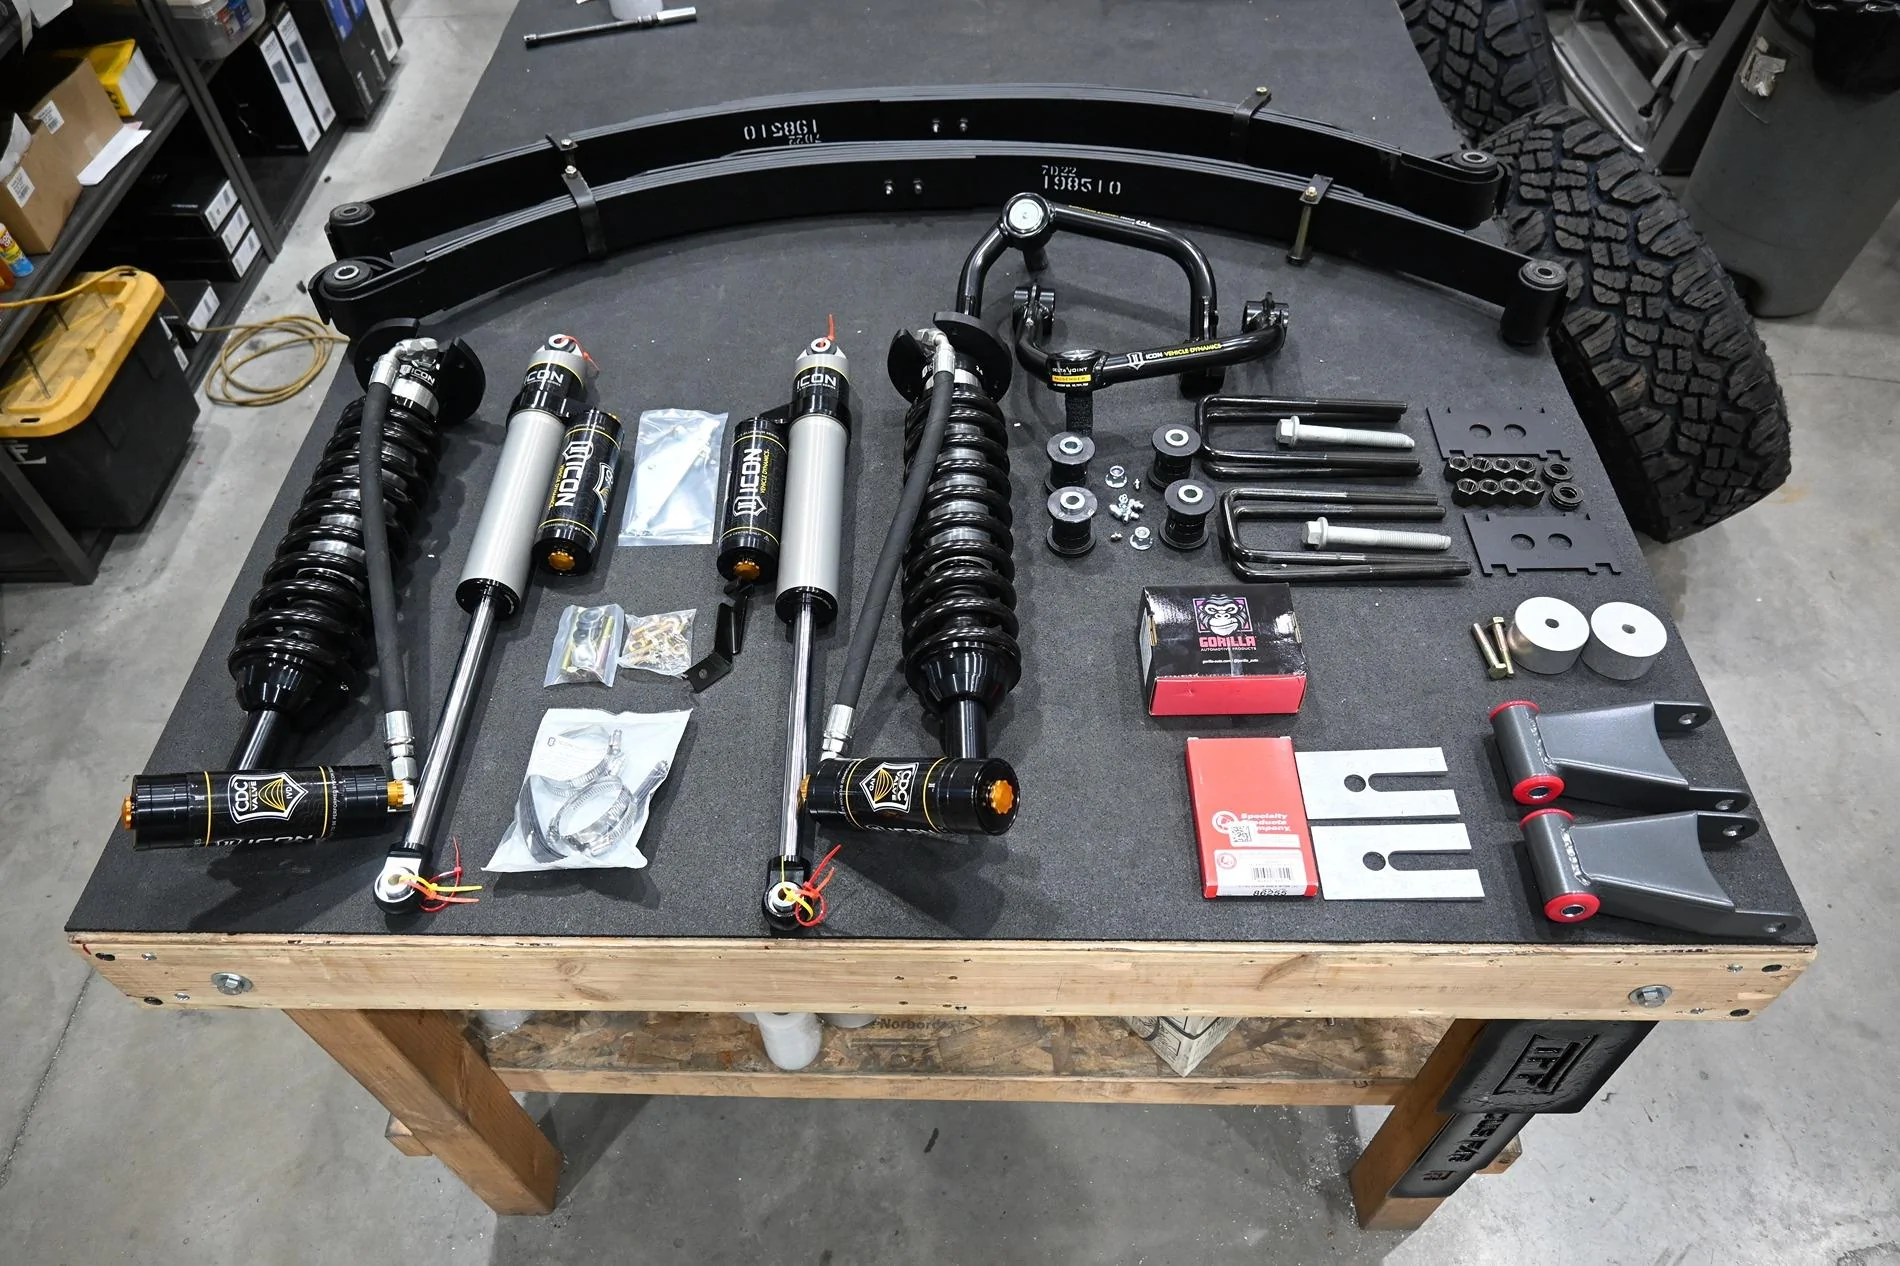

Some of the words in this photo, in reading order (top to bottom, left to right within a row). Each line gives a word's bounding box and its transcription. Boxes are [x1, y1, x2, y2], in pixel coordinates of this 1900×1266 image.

[743, 119, 817, 140] 198510
[1044, 175, 1121, 195] 198510
[1145, 351, 1163, 360] ICON
[1163, 348, 1189, 358] VEHICLE
[1189, 343, 1222, 353] DYNAMICS
[410, 367, 436, 384] ICON
[525, 369, 564, 385] ICON
[797, 373, 837, 390] ICON
[739, 448, 763, 494] ICON
[761, 448, 770, 474] DYNAMICS
[555, 461, 586, 507] ICON
[759, 475, 768, 493] VEHICLE
[1199, 636, 1256, 647] GORILLA
[234, 781, 248, 812] CDC
[250, 780, 259, 811] VALVE
[891, 771, 901, 801] VALVE
[898, 770, 912, 802] CDC
